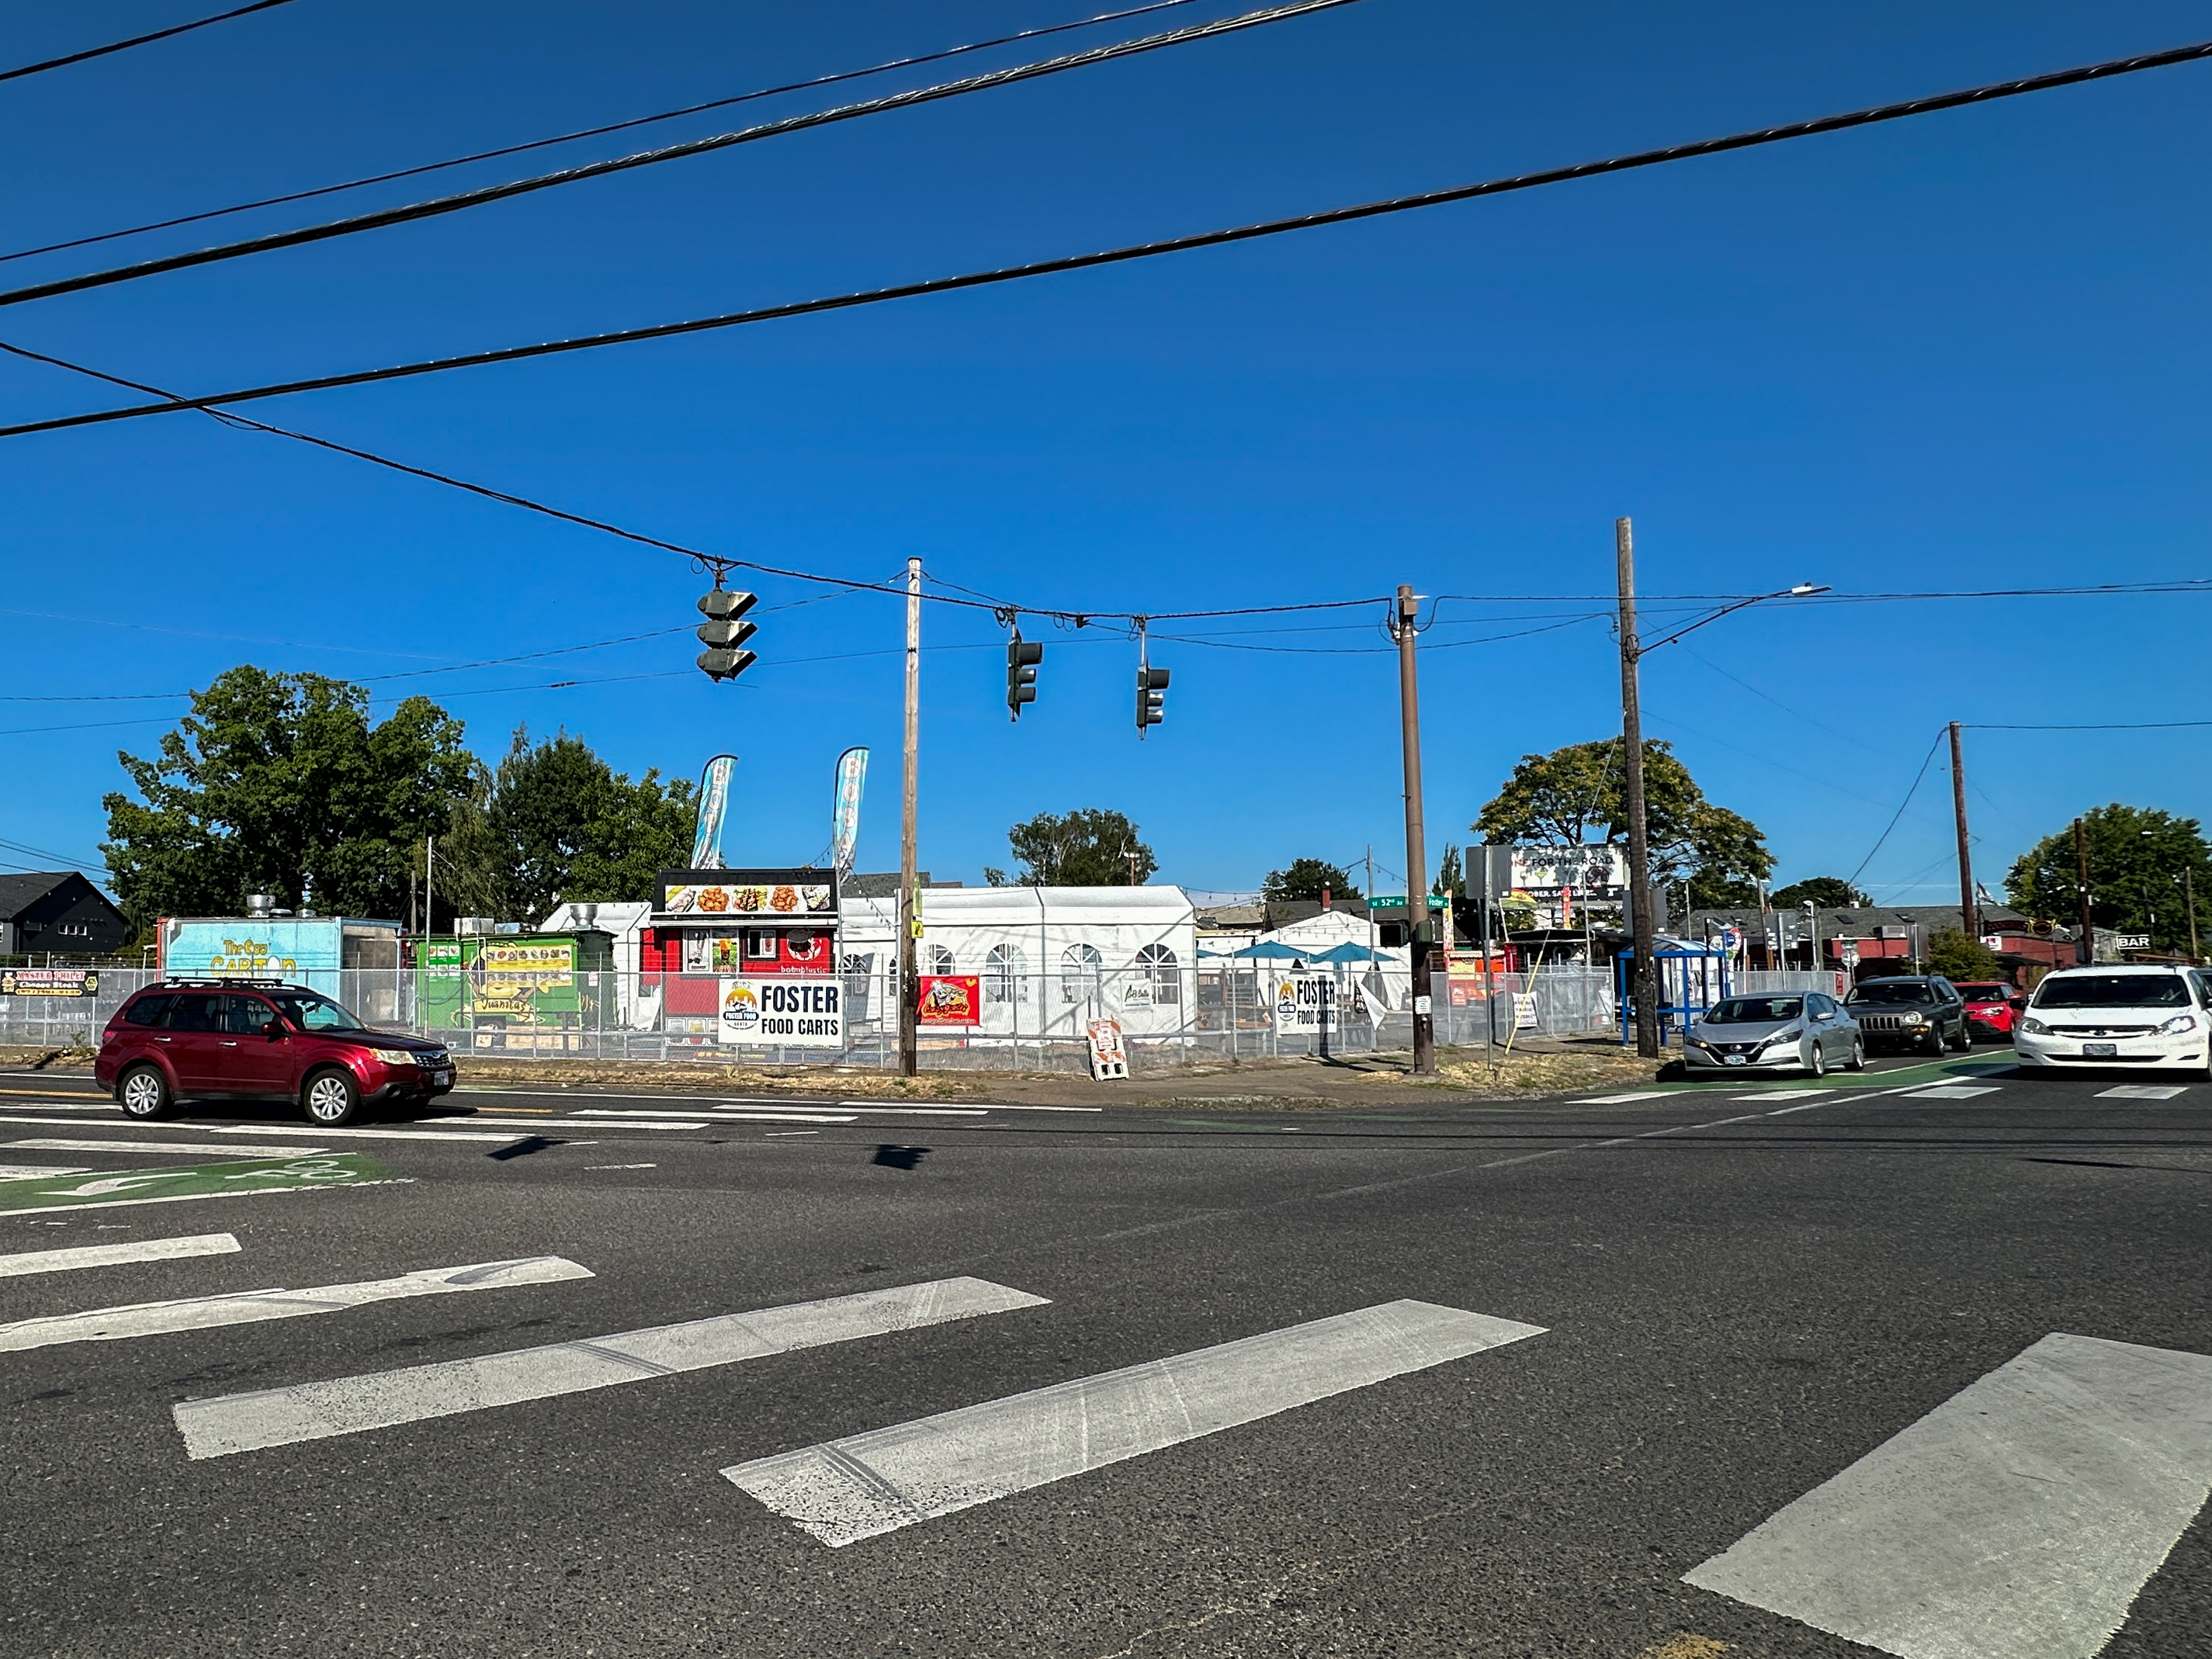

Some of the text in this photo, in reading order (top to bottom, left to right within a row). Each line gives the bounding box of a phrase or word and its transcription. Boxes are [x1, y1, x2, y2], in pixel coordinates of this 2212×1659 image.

[842, 756, 861, 850] BOBA
[1532, 857, 1555, 867] FOR
[223, 939, 244, 955] The
[2118, 937, 2150, 947] BAR
[761, 985, 838, 1013] FOSTER
[1297, 979, 1336, 1005] FOSTER
[744, 1012, 757, 1020] FOOD
[1297, 1010, 1336, 1025] FOOD CARTS
[761, 1018, 793, 1034] FOOD
[798, 1019, 838, 1035] CARTS
